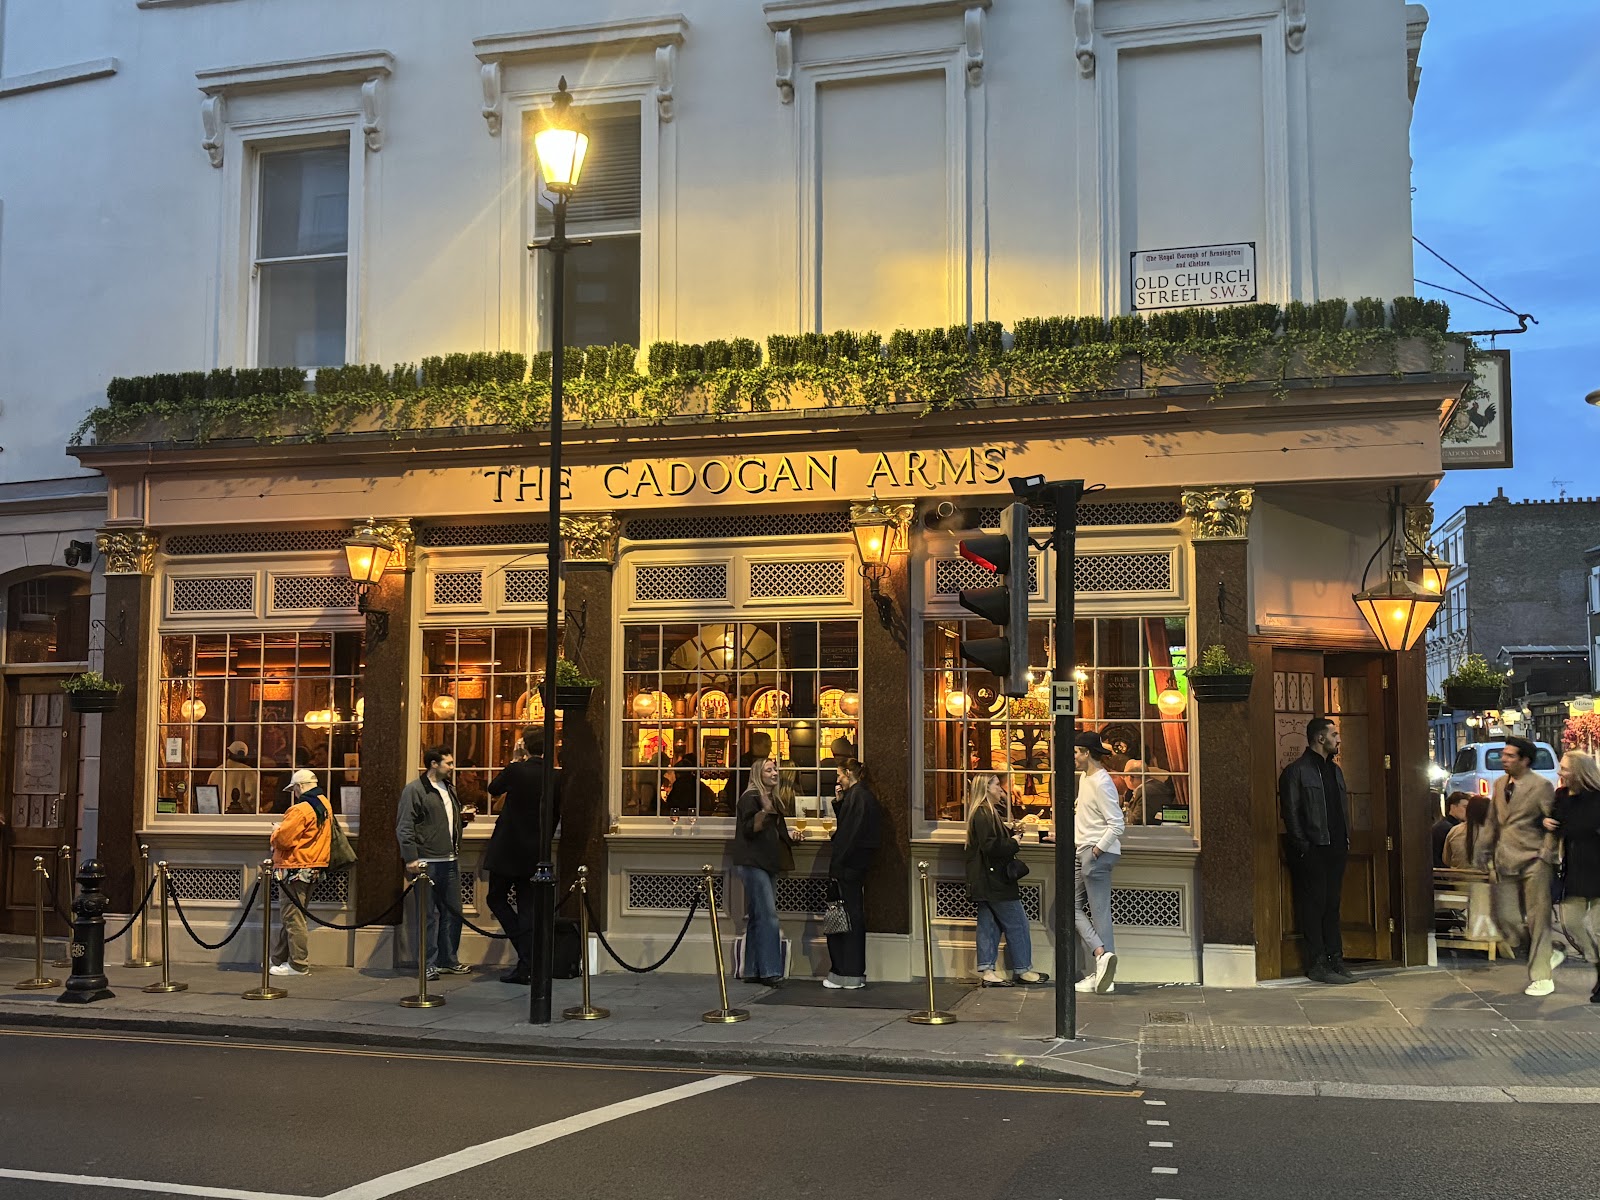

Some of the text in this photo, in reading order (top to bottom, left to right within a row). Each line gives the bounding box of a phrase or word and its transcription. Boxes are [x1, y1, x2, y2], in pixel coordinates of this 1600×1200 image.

[1158, 254, 1175, 262] Royal
[1176, 252, 1199, 260] Borough
[1201, 250, 1208, 258] of
[1209, 249, 1241, 258] Kensington
[1175, 260, 1210, 269] and Chelsea
[1135, 269, 1250, 290] OLD CHURCH
[1210, 285, 1248, 300] S.W.3
[603, 454, 837, 499] CADOGAN
[866, 446, 1007, 489] ARMS
